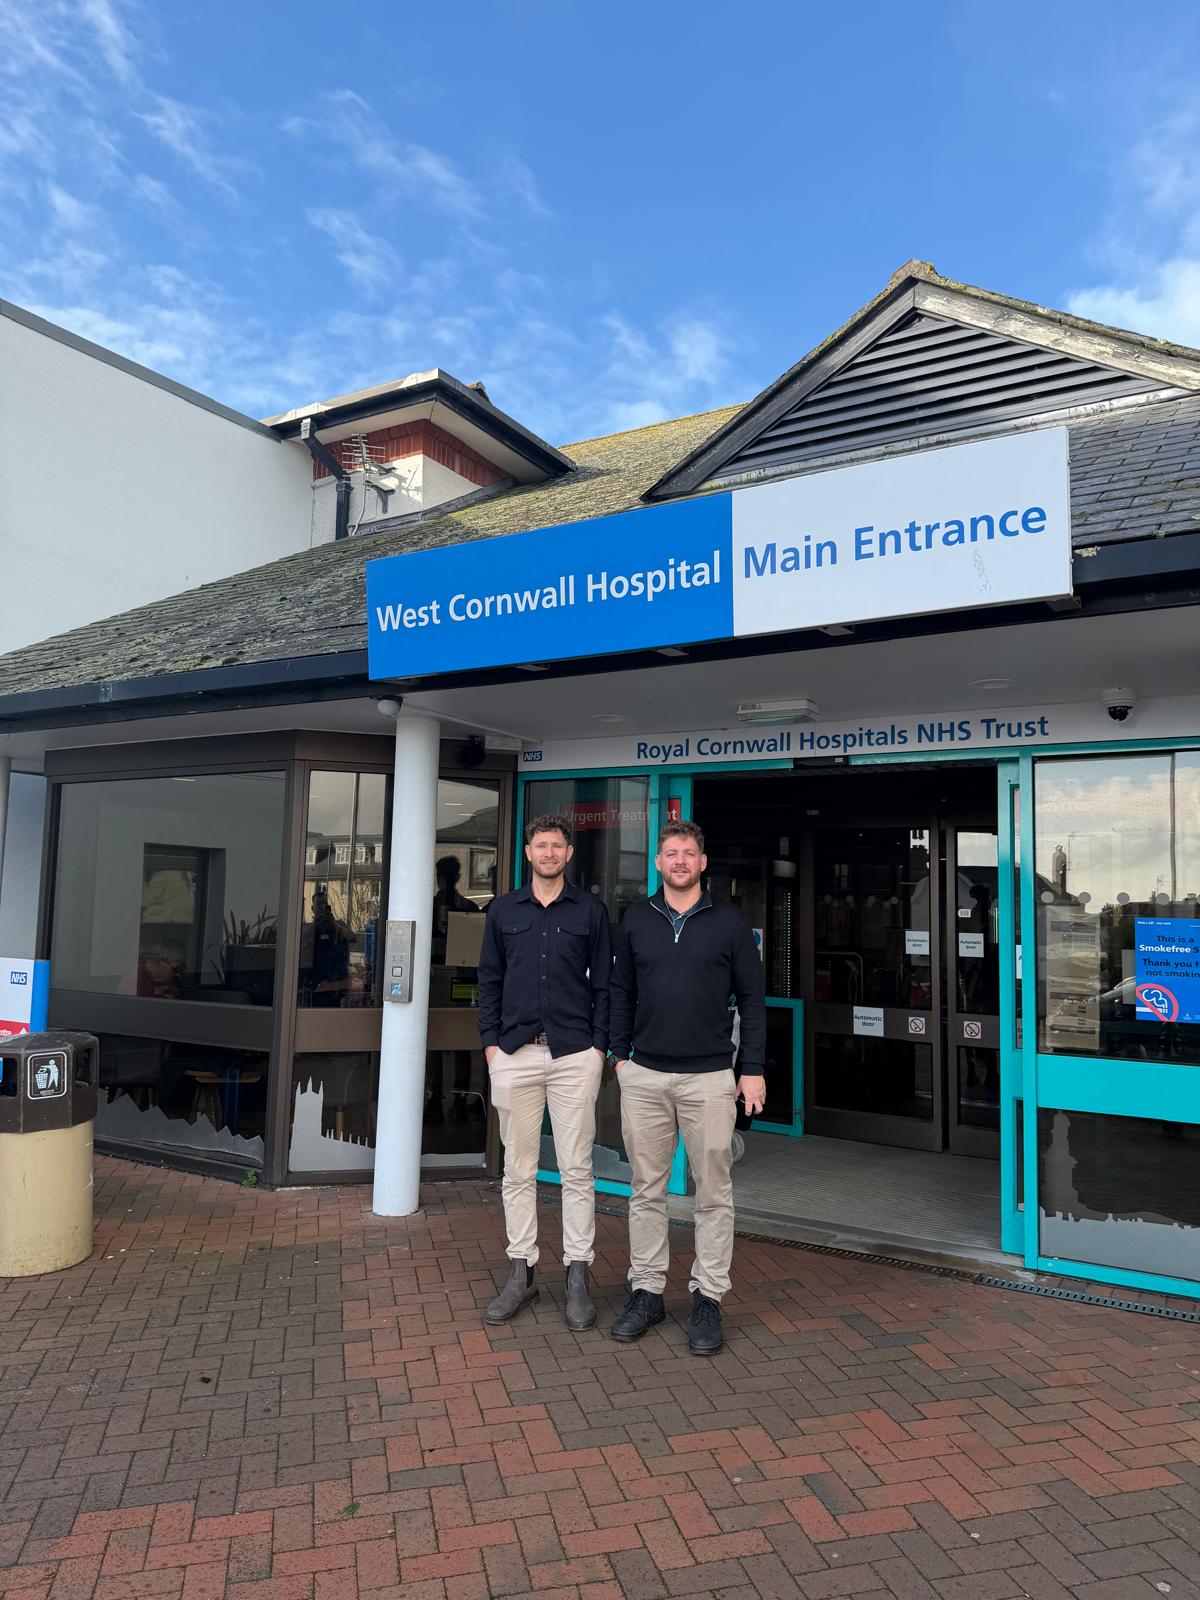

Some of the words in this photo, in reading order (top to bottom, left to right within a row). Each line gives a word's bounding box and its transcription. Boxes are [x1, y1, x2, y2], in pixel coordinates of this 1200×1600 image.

[744, 535, 837, 579] Main
[854, 505, 1047, 561] Entrance
[376, 600, 441, 632] West
[448, 575, 575, 622] Cornwall
[586, 550, 721, 603] Hospital
[637, 738, 690, 762] Royal
[696, 731, 792, 756] Cornwall
[799, 724, 908, 754] Hospitals
[917, 720, 972, 743] NHS
[980, 715, 1049, 739] Trust
[524, 751, 542, 761] NHS
[1156, 935, 1176, 943] This
[1178, 935, 1186, 943] is
[1139, 944, 1191, 953] Smokefree
[1142, 958, 1171, 967] Thank
[1174, 960, 1192, 969] you
[11, 972, 27, 985] NHS
[1146, 969, 1162, 977] not
